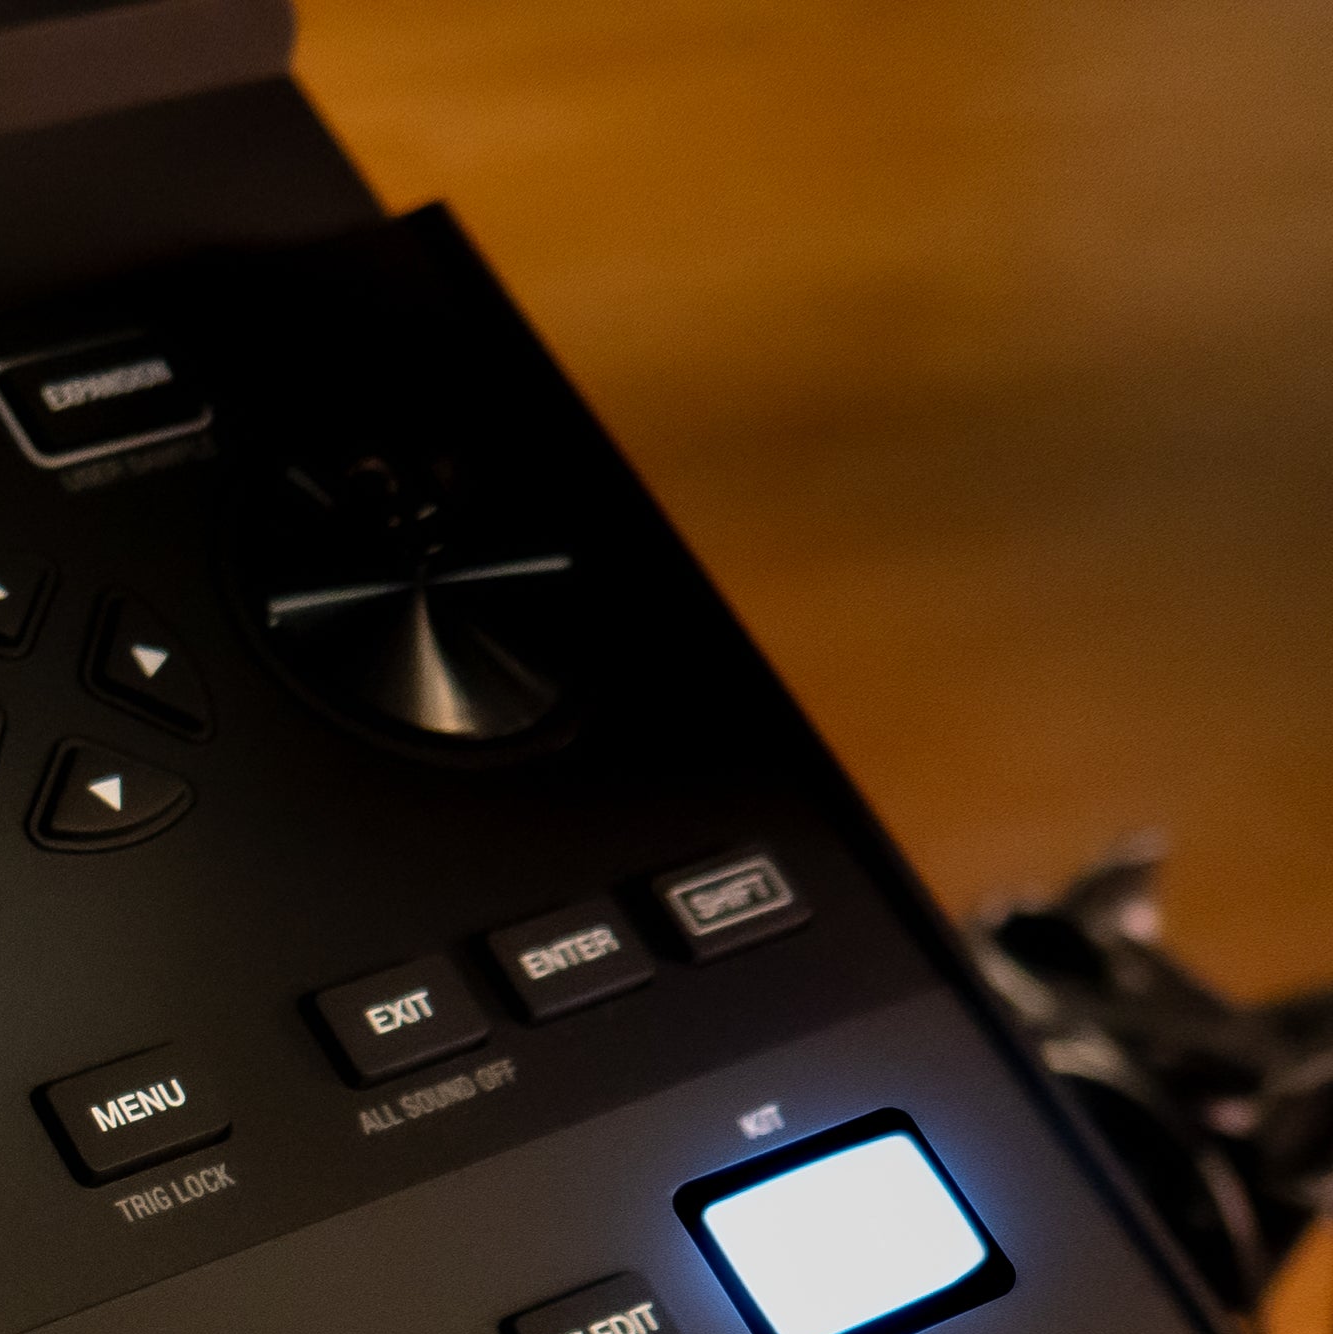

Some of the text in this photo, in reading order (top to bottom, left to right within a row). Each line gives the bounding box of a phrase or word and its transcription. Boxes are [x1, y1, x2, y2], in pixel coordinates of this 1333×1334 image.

[520, 924, 621, 980] ENTER
[364, 989, 434, 1035] EXIT
[90, 1078, 187, 1132] MENU
[114, 1163, 238, 1225] TRIG LOCK
